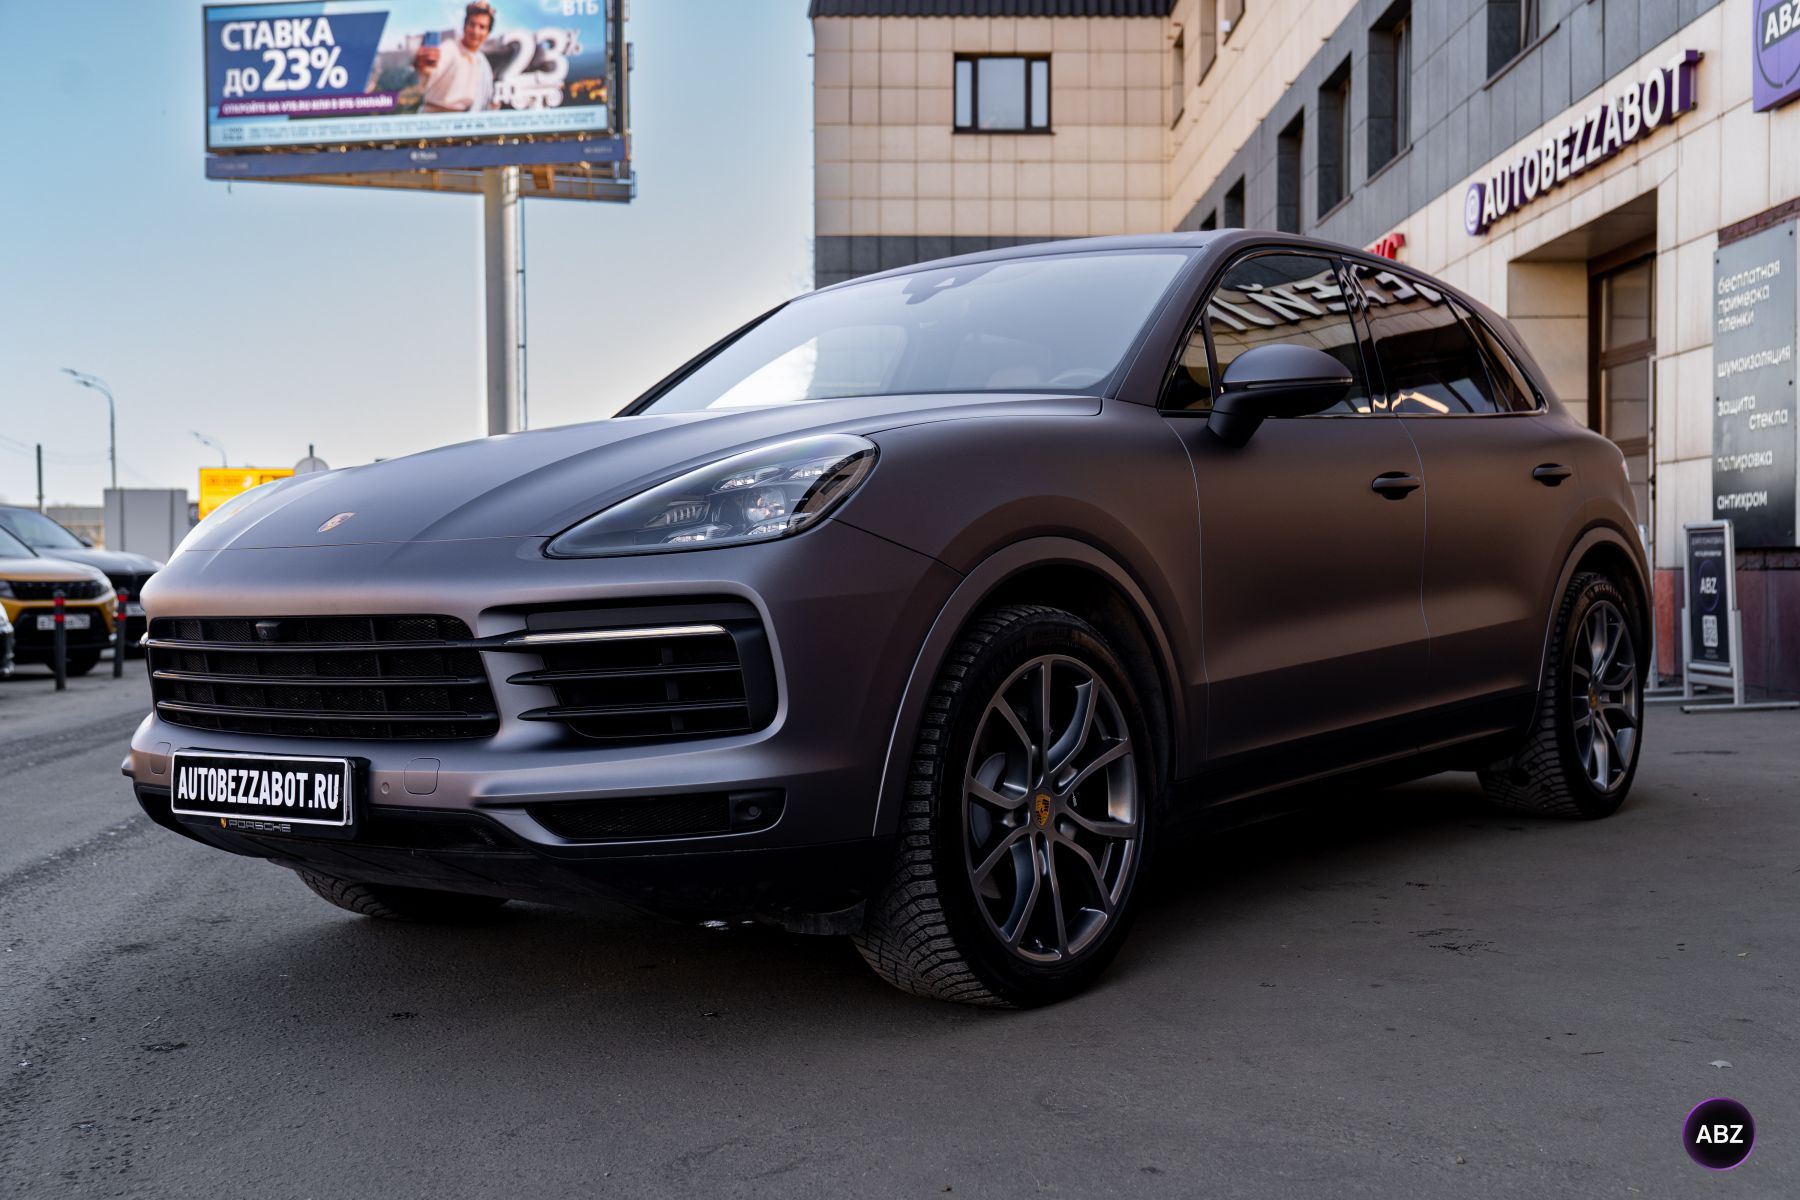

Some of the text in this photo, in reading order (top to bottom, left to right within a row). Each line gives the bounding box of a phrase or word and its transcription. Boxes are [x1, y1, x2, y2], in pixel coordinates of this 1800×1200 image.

[221, 16, 336, 52] СТАВКА
[262, 46, 349, 92] 23%
[1481, 50, 1689, 226] AUTOBEZZABOT
[1718, 259, 1780, 295] бесплатная
[1718, 284, 1770, 314] примерка
[1718, 312, 1754, 333] пленки
[1717, 345, 1791, 379] шумоизоляция
[1717, 393, 1756, 417] защита
[1749, 408, 1788, 431] стекла
[1716, 449, 1773, 474] полировка
[1717, 489, 1768, 512] антихром
[1700, 577, 1718, 594] ABZ
[177, 766, 340, 810] AUTOBEZZABOT.RU
[228, 819, 292, 833] PORSCHE
